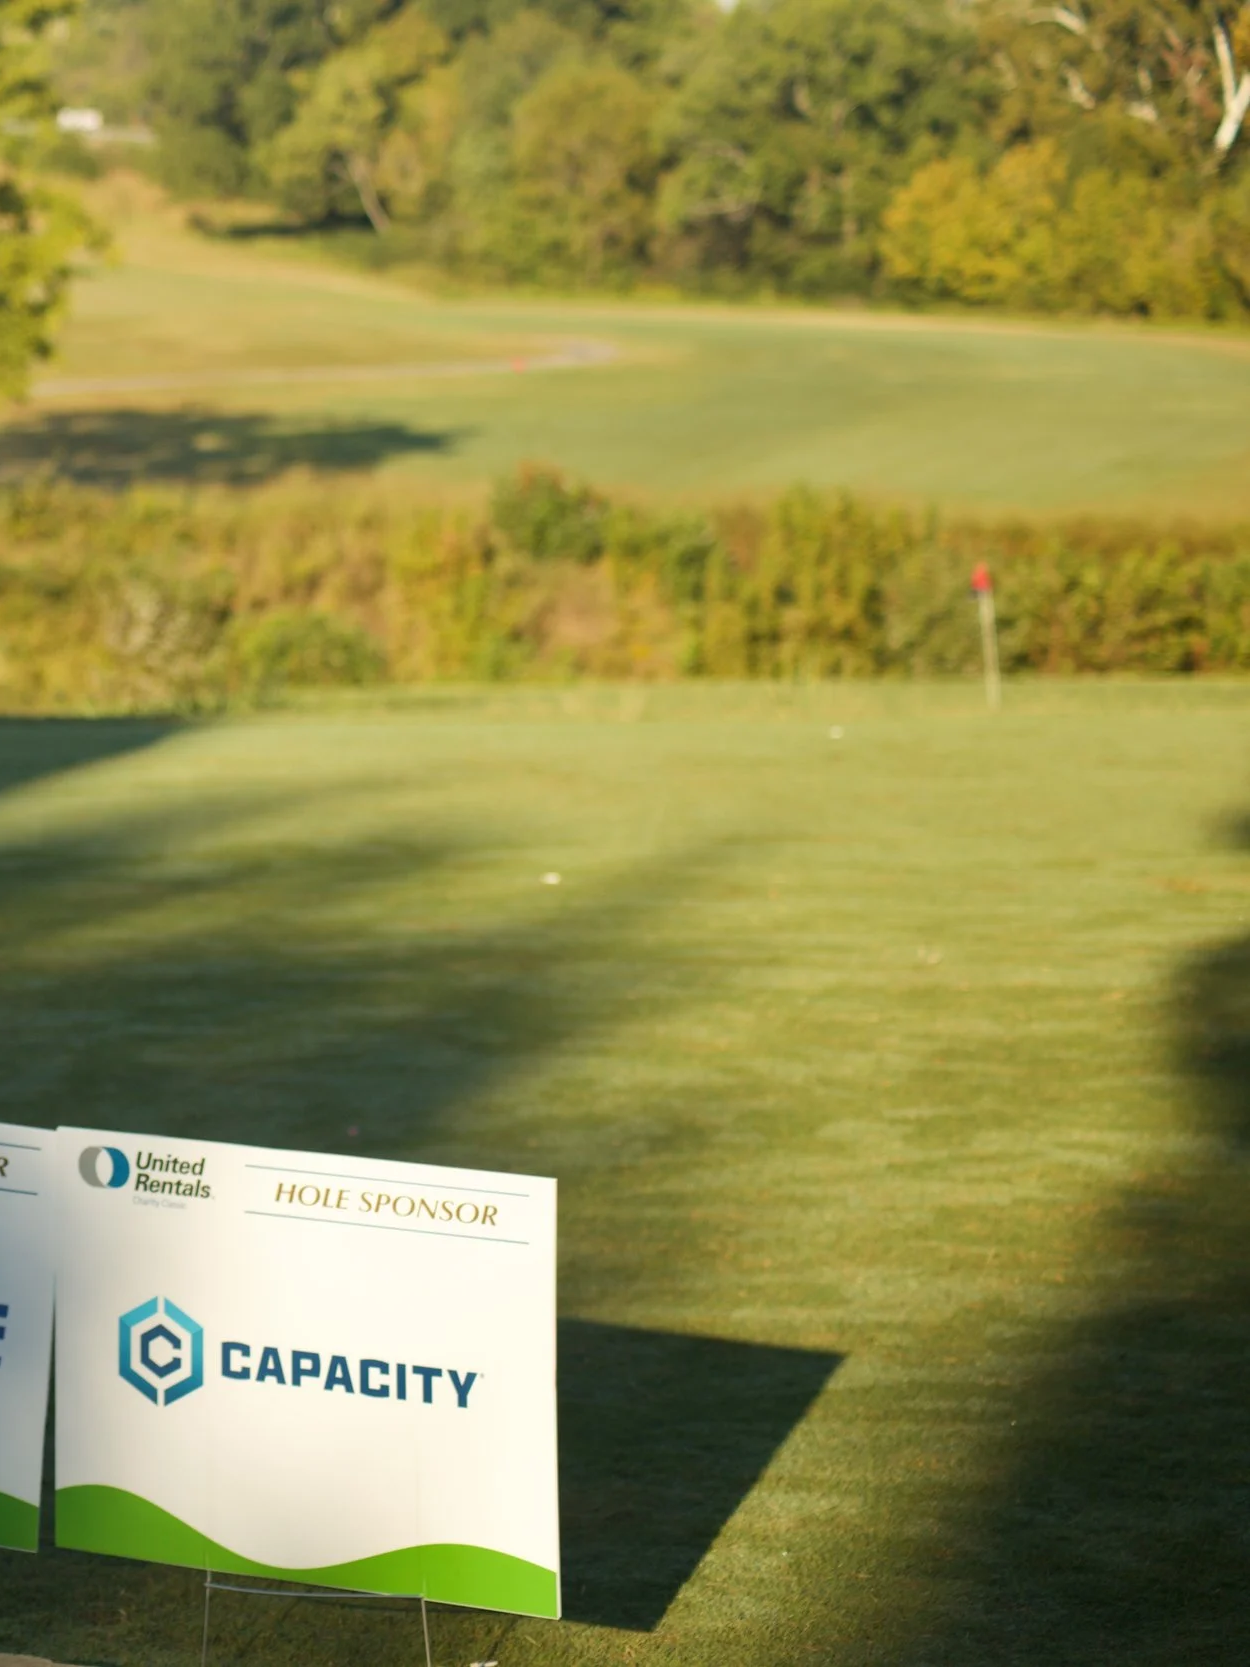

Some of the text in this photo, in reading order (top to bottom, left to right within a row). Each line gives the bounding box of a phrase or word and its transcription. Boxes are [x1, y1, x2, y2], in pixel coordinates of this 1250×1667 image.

[136, 1151, 206, 1176] United
[134, 1173, 212, 1199] Rentals
[274, 1181, 499, 1227] HOLE SPONSOR
[221, 1340, 479, 1409] CAPACITY
